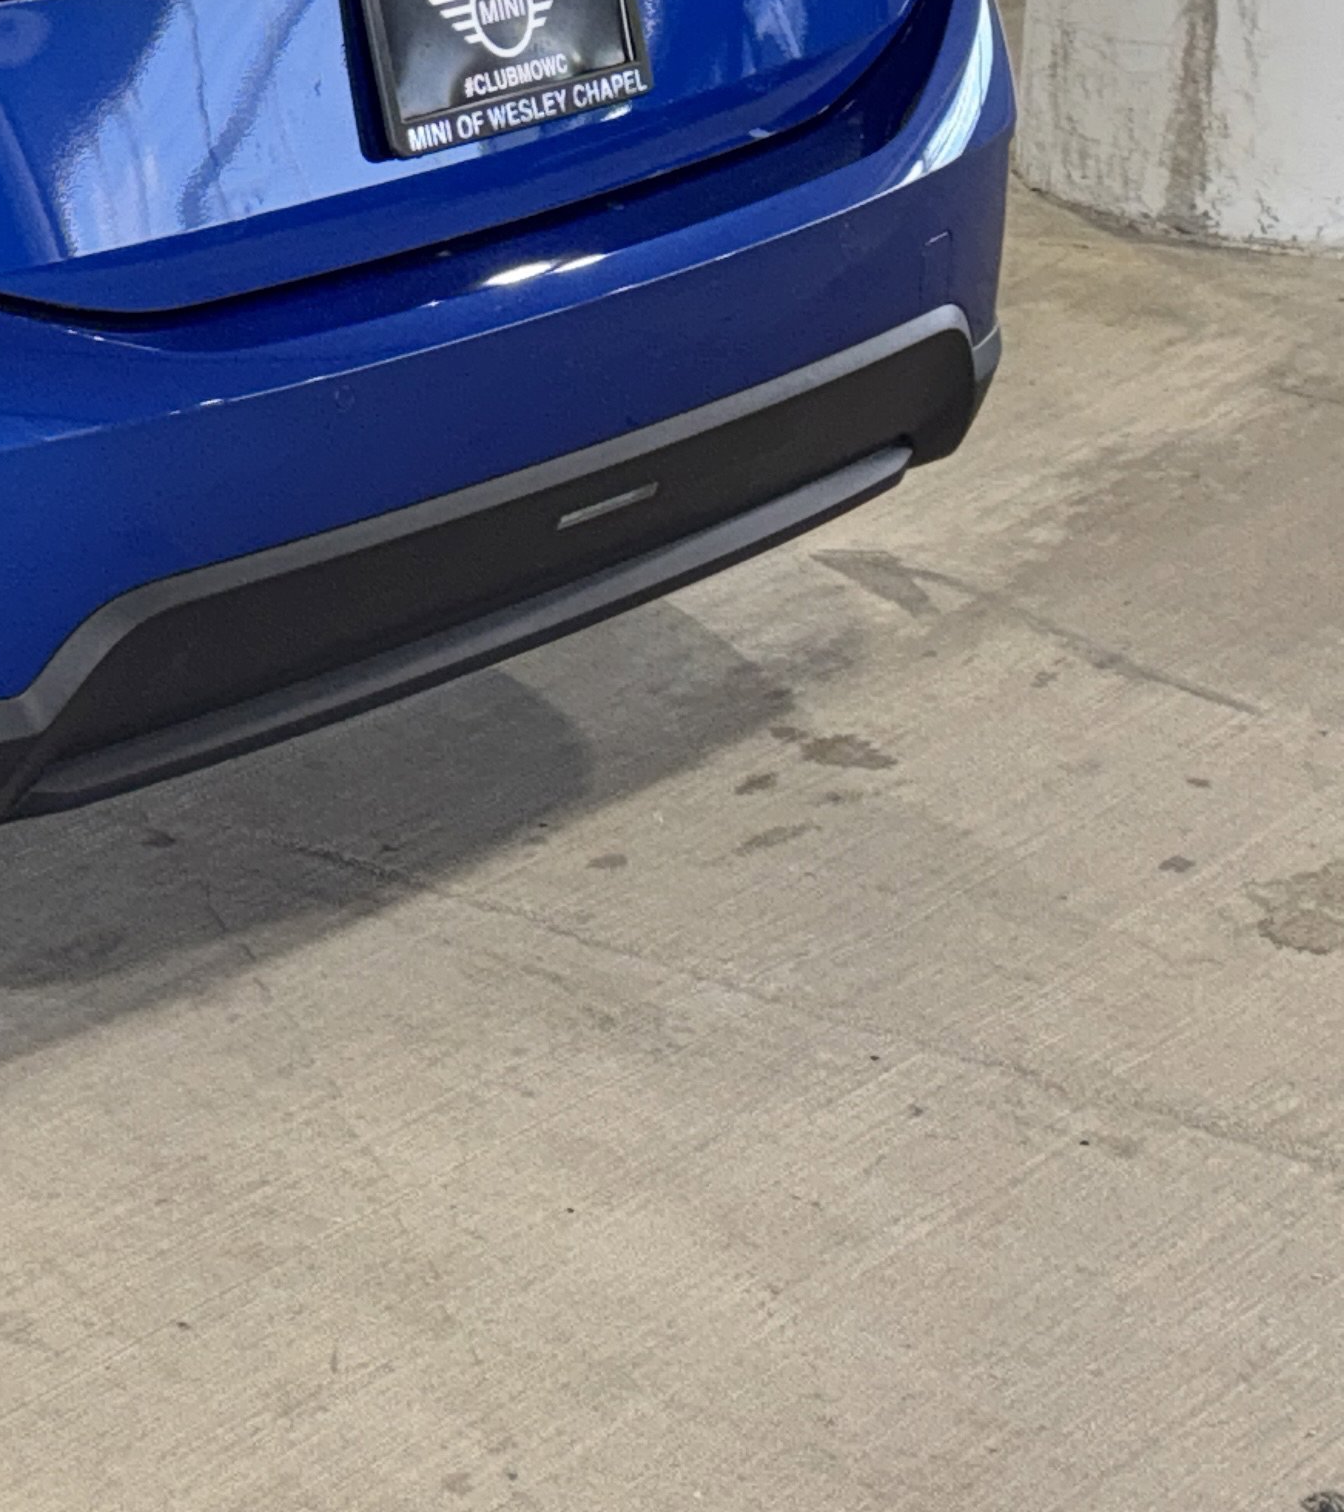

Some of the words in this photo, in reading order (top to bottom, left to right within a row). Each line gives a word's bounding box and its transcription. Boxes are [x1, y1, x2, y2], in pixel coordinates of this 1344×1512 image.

[463, 54, 568, 98] #CLUBMOWC
[407, 120, 453, 152] MINI
[457, 111, 485, 139] OF
[486, 89, 568, 131] WESLEY
[572, 69, 648, 108] CHAPEL
